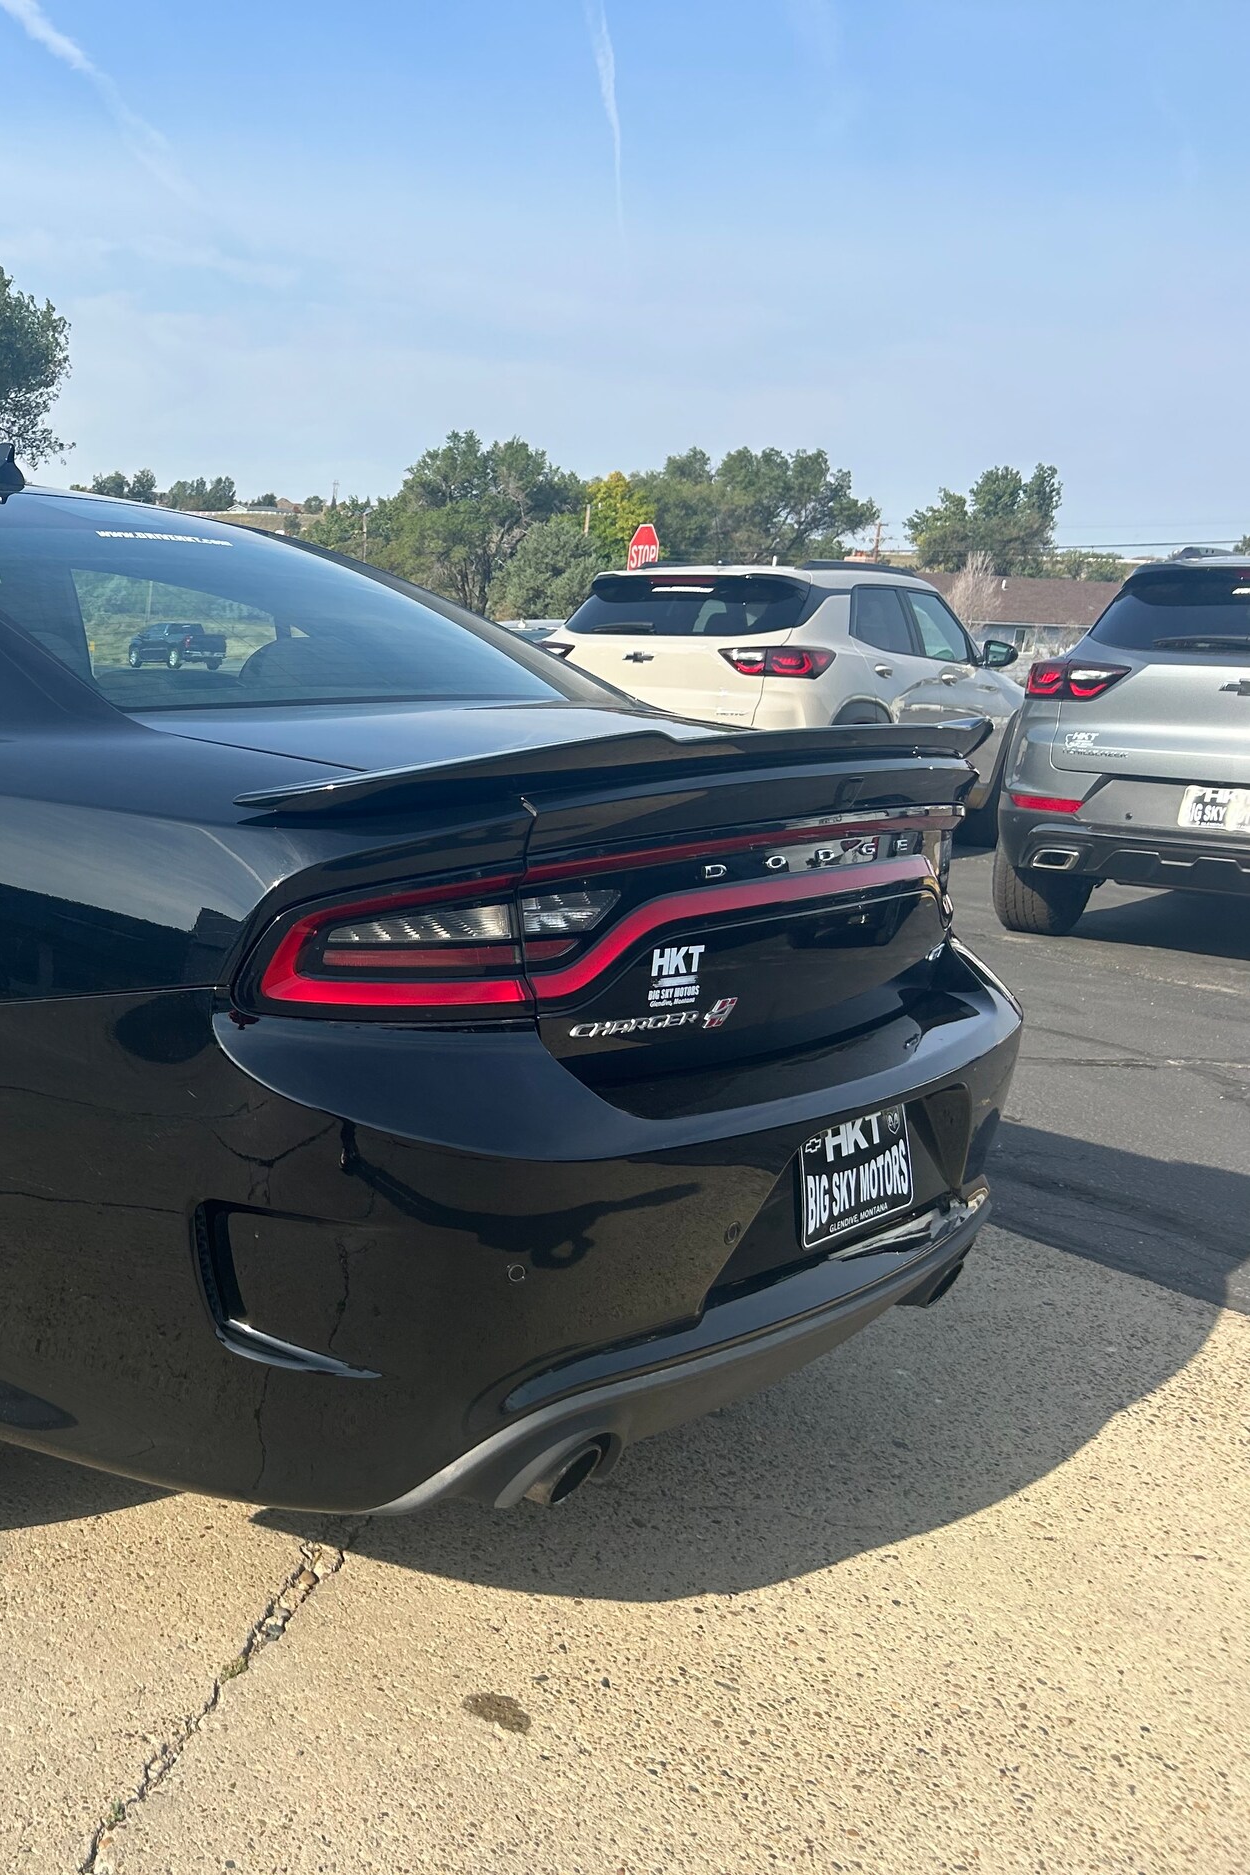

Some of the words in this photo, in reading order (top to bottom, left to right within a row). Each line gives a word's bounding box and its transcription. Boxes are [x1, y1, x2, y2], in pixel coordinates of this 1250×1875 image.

[630, 545, 656, 568] STOP
[1203, 804, 1227, 822] SKY
[705, 839, 908, 879] DODGE
[651, 945, 705, 976] HKT
[648, 990, 660, 1000] BIG
[661, 988, 674, 999] SKY
[674, 985, 700, 997] MOTORS
[569, 1011, 700, 1037] CHARGER
[825, 1112, 881, 1162] HKT
[806, 1174, 830, 1235] BIG
[832, 1167, 857, 1217] SKY
[859, 1138, 909, 1203] MOTORS
[829, 1214, 860, 1233] GLENDIVE,
[859, 1202, 889, 1222] MONTANA
